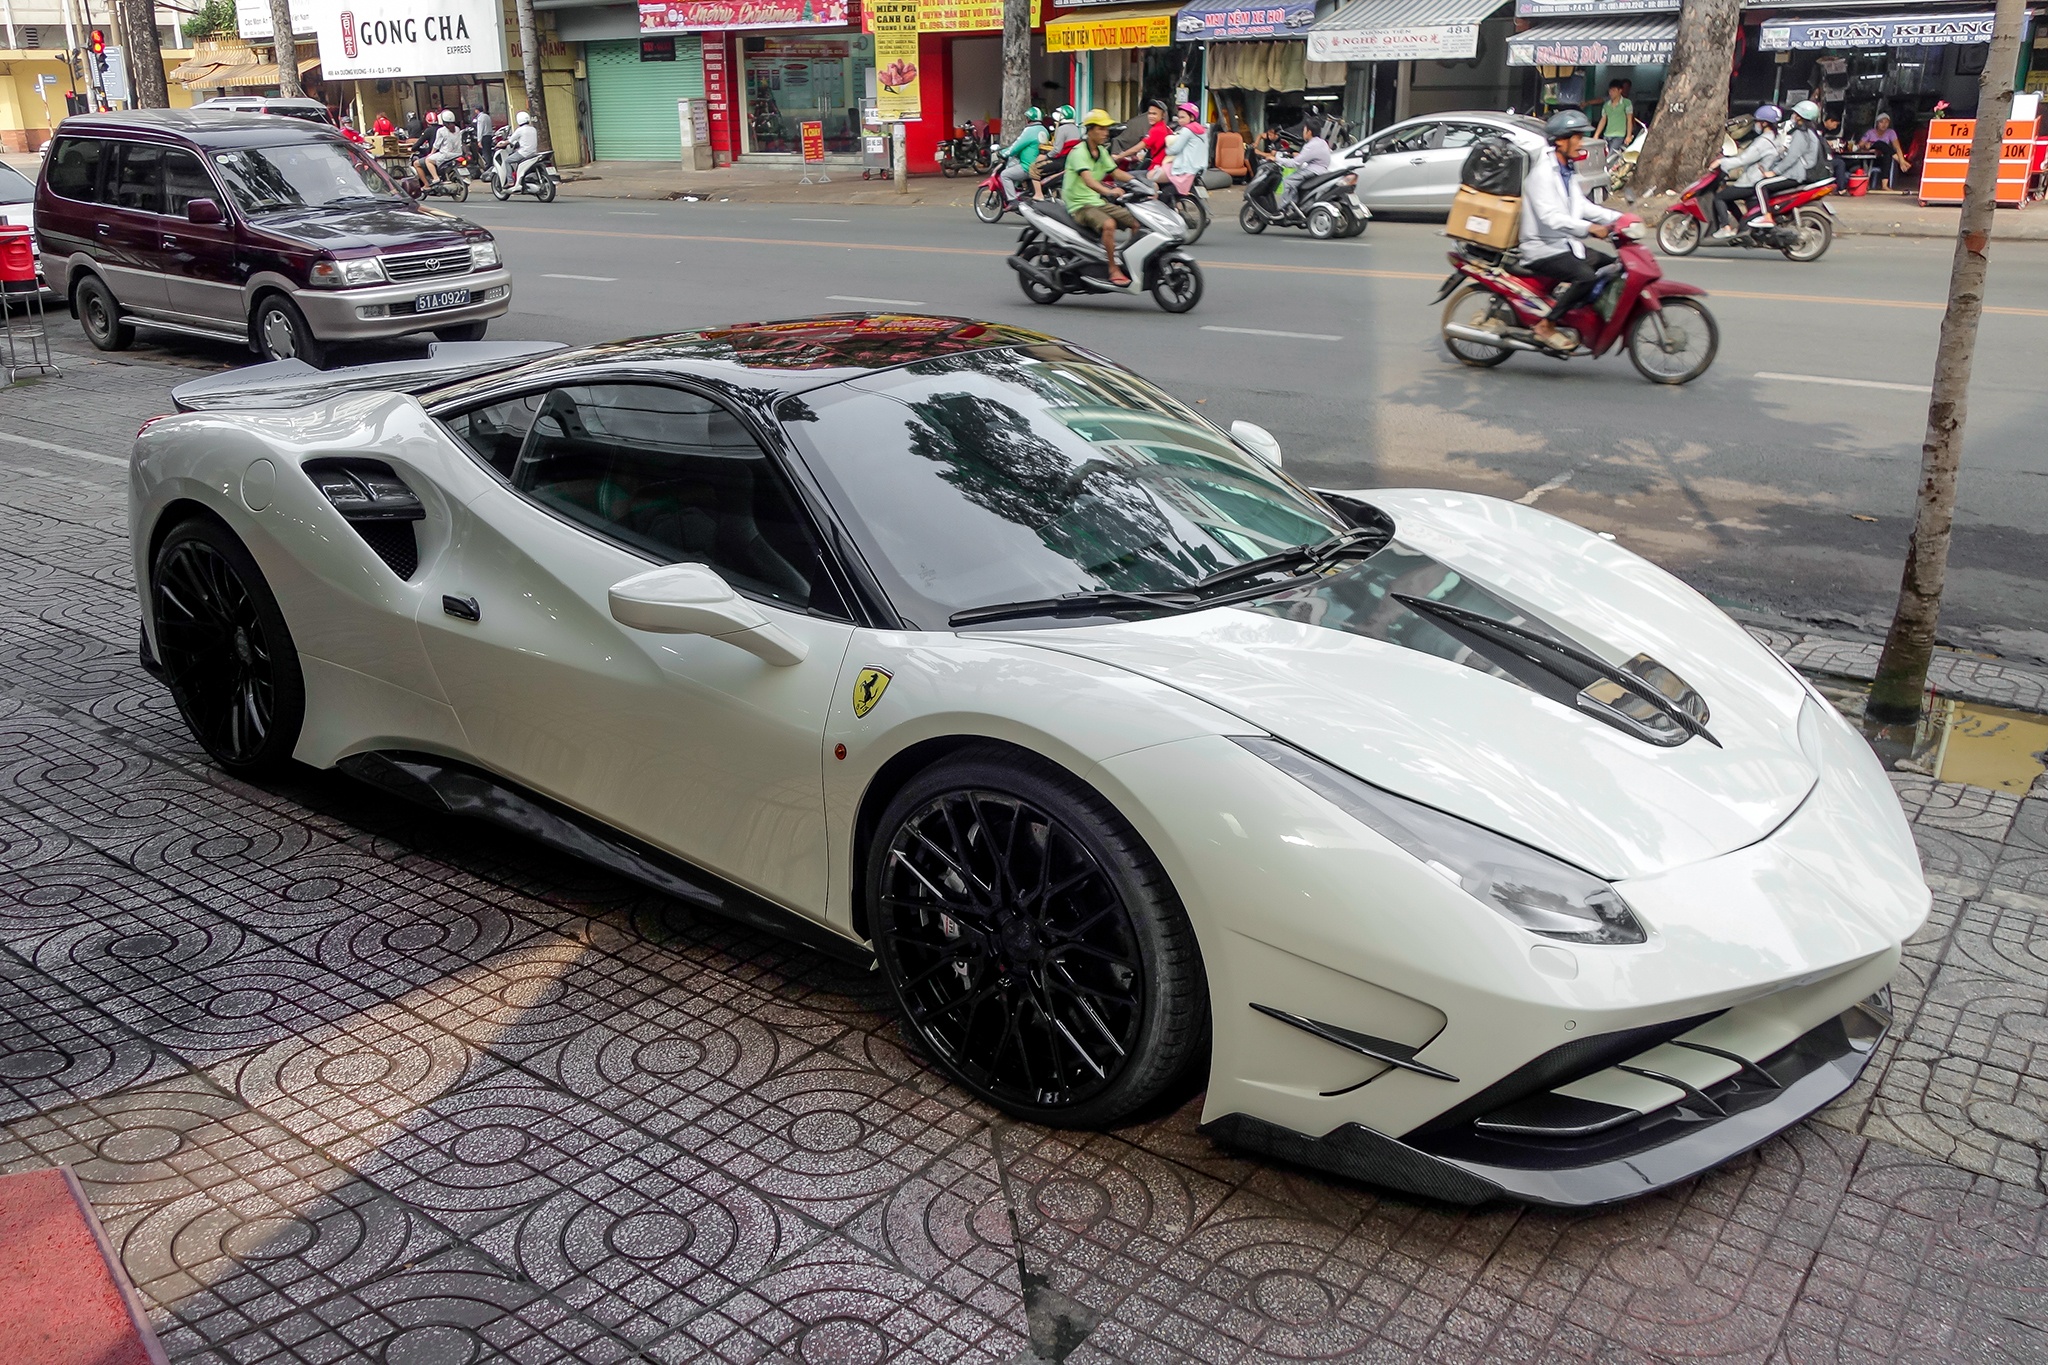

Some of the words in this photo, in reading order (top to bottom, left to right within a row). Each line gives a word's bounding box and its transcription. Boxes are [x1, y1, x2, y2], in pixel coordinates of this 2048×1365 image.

[688, 1, 736, 24] Merry
[738, 0, 799, 23] Christmas
[1205, 13, 1227, 27] MAY
[1251, 10, 1265, 24] XE
[360, 18, 418, 46] GONG
[424, 14, 470, 41] CHA
[1120, 25, 1148, 45] MINH
[1446, 26, 1471, 34] 484
[1893, 20, 1994, 37] KHANG
[1382, 34, 1428, 46] QUANG
[1618, 40, 1657, 52] CHUYÊN
[446, 45, 472, 55] EXPRESS
[1652, 53, 1666, 63] XE
[1949, 123, 1969, 137] Trà
[1930, 144, 1942, 155] Hạt
[1948, 144, 1970, 157] Chia
[2004, 145, 2026, 157] 10K
